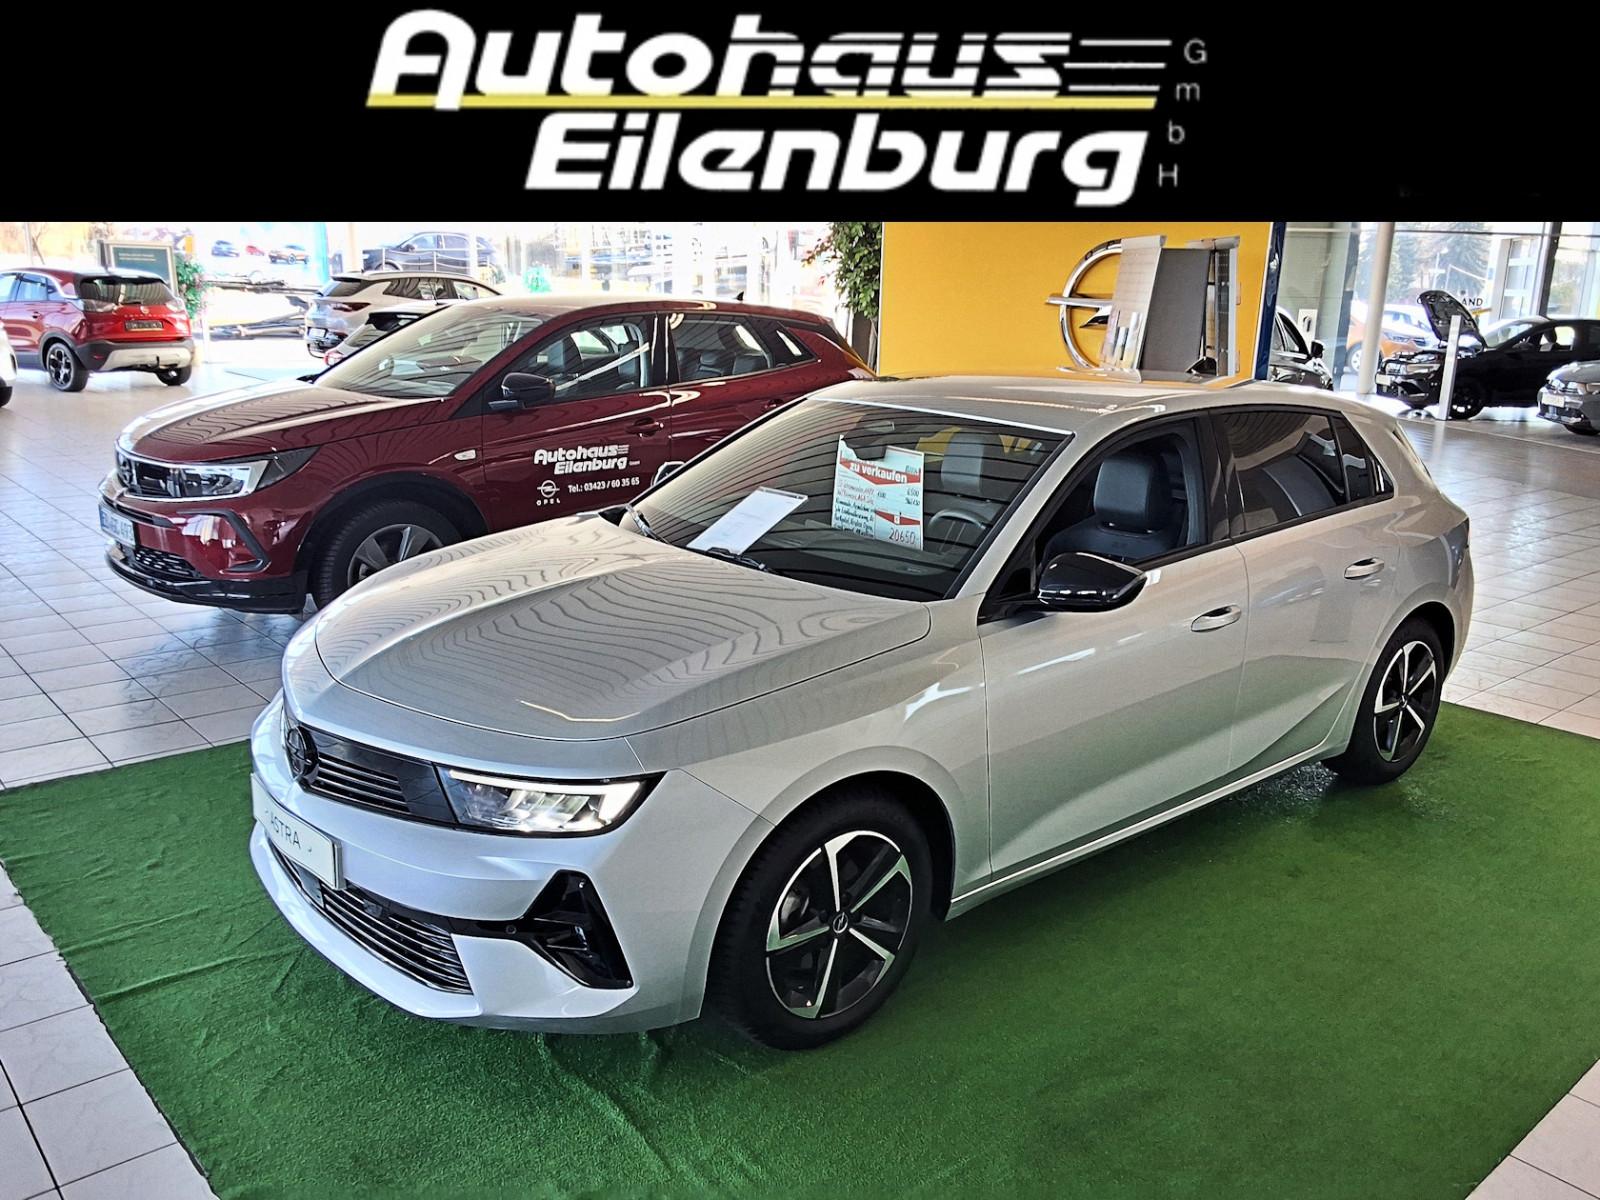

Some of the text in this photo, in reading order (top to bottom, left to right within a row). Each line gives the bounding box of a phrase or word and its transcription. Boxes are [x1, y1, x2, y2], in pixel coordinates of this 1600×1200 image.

[534, 445, 620, 465] Autohaus
[554, 457, 628, 475] Eilenburg
[849, 462, 860, 471] zu
[862, 464, 908, 484] verkaufen
[568, 484, 583, 494] Tel.:
[584, 481, 606, 492] 03423
[611, 479, 621, 489] 60
[621, 478, 630, 488] 35
[631, 476, 640, 486] 65
[271, 811, 301, 849] ASTRA
